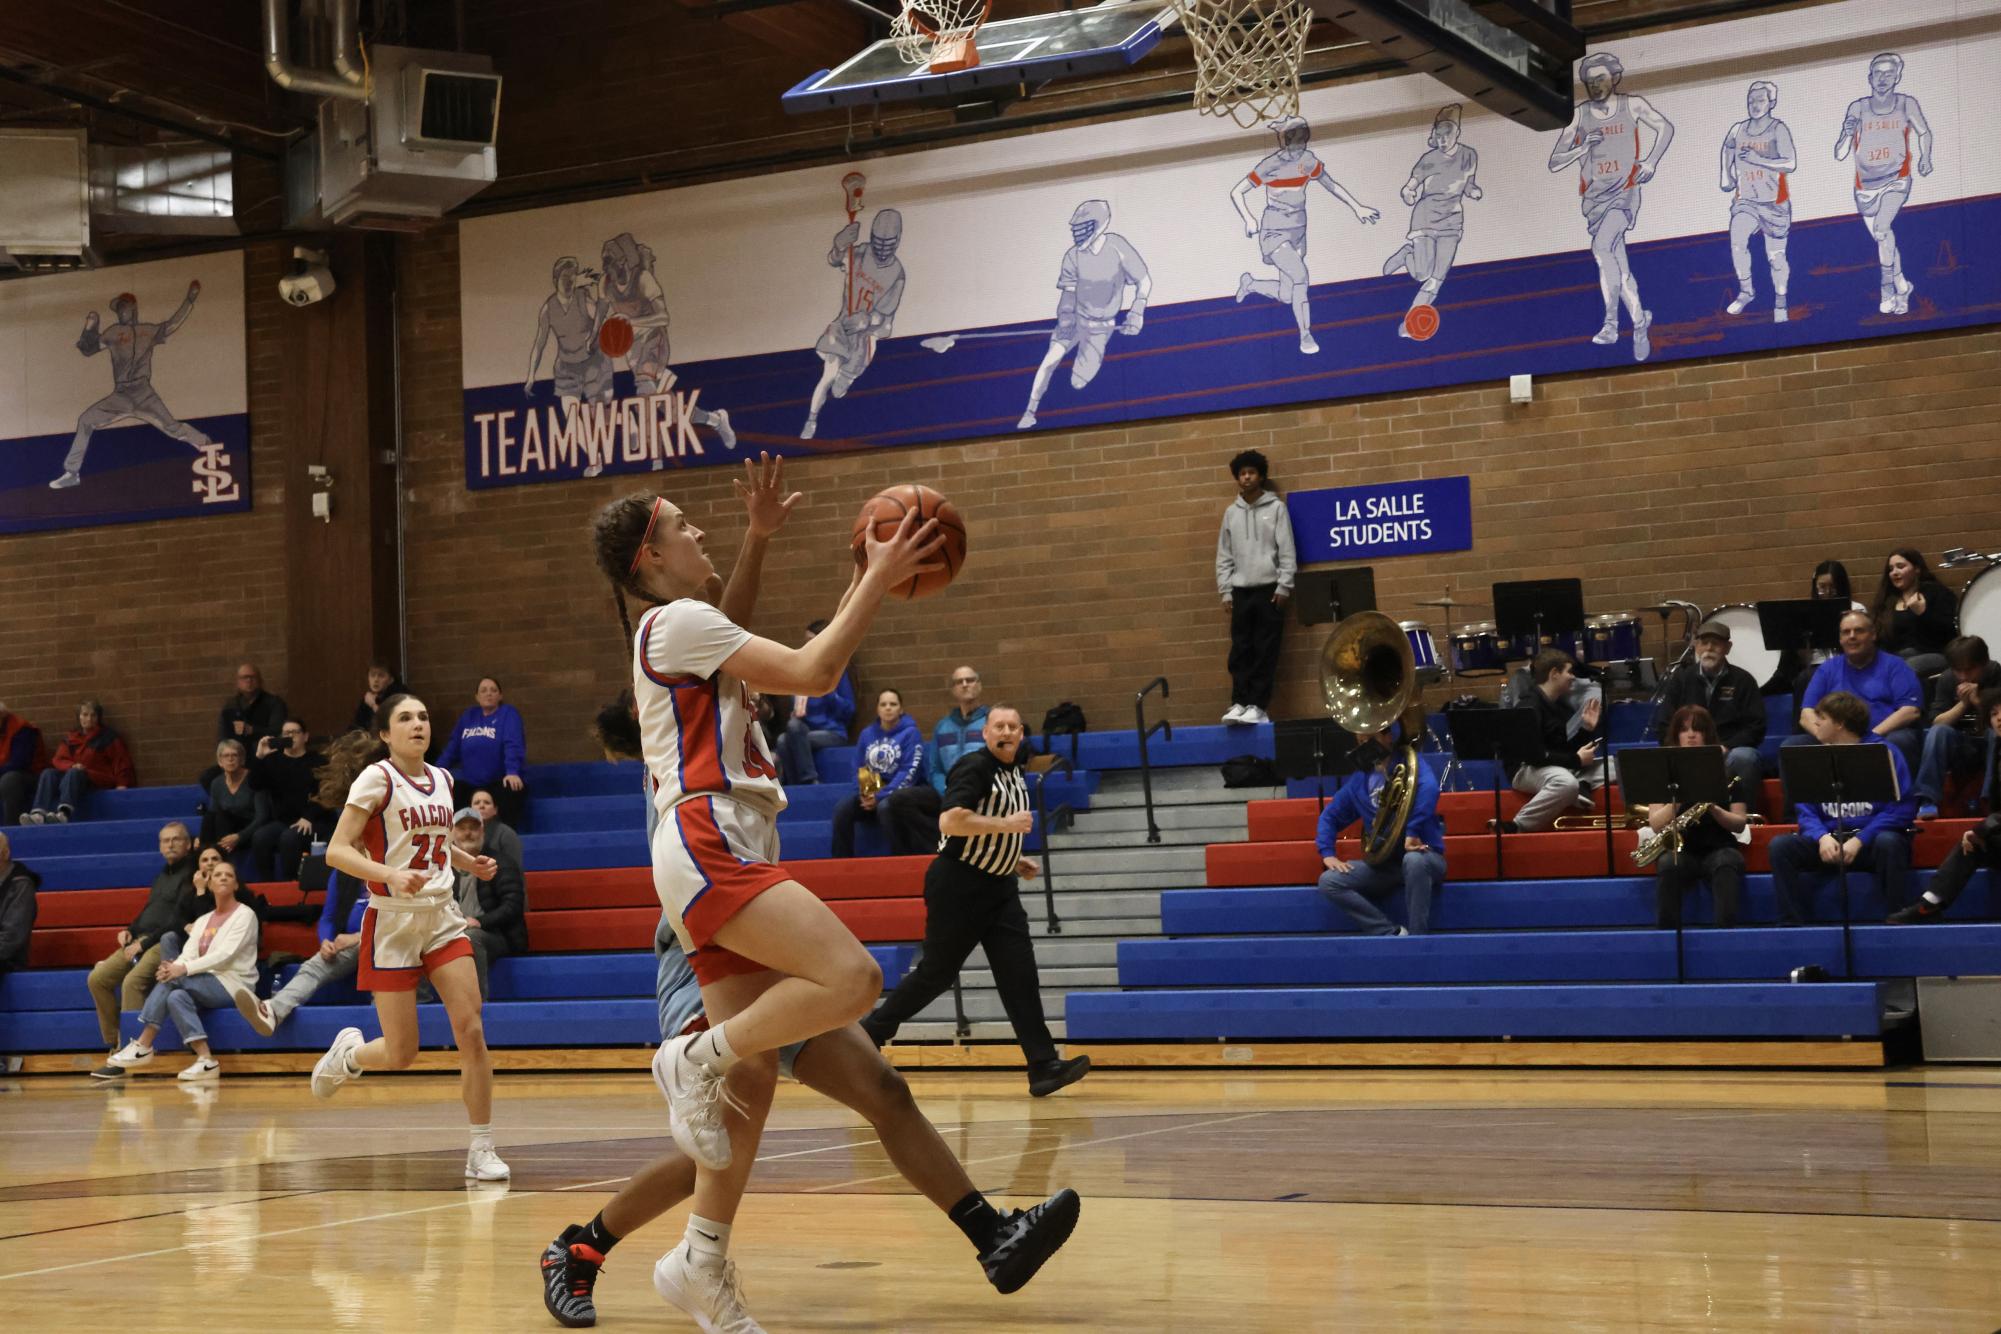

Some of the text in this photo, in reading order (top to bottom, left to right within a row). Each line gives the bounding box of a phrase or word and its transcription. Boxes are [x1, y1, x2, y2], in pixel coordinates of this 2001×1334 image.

[1598, 160, 1620, 175] 321
[473, 388, 704, 477] TEAMWORK
[1335, 493, 1425, 521] LA SALLE
[1330, 519, 1433, 547] STUDENTS
[408, 834, 448, 871] 24
